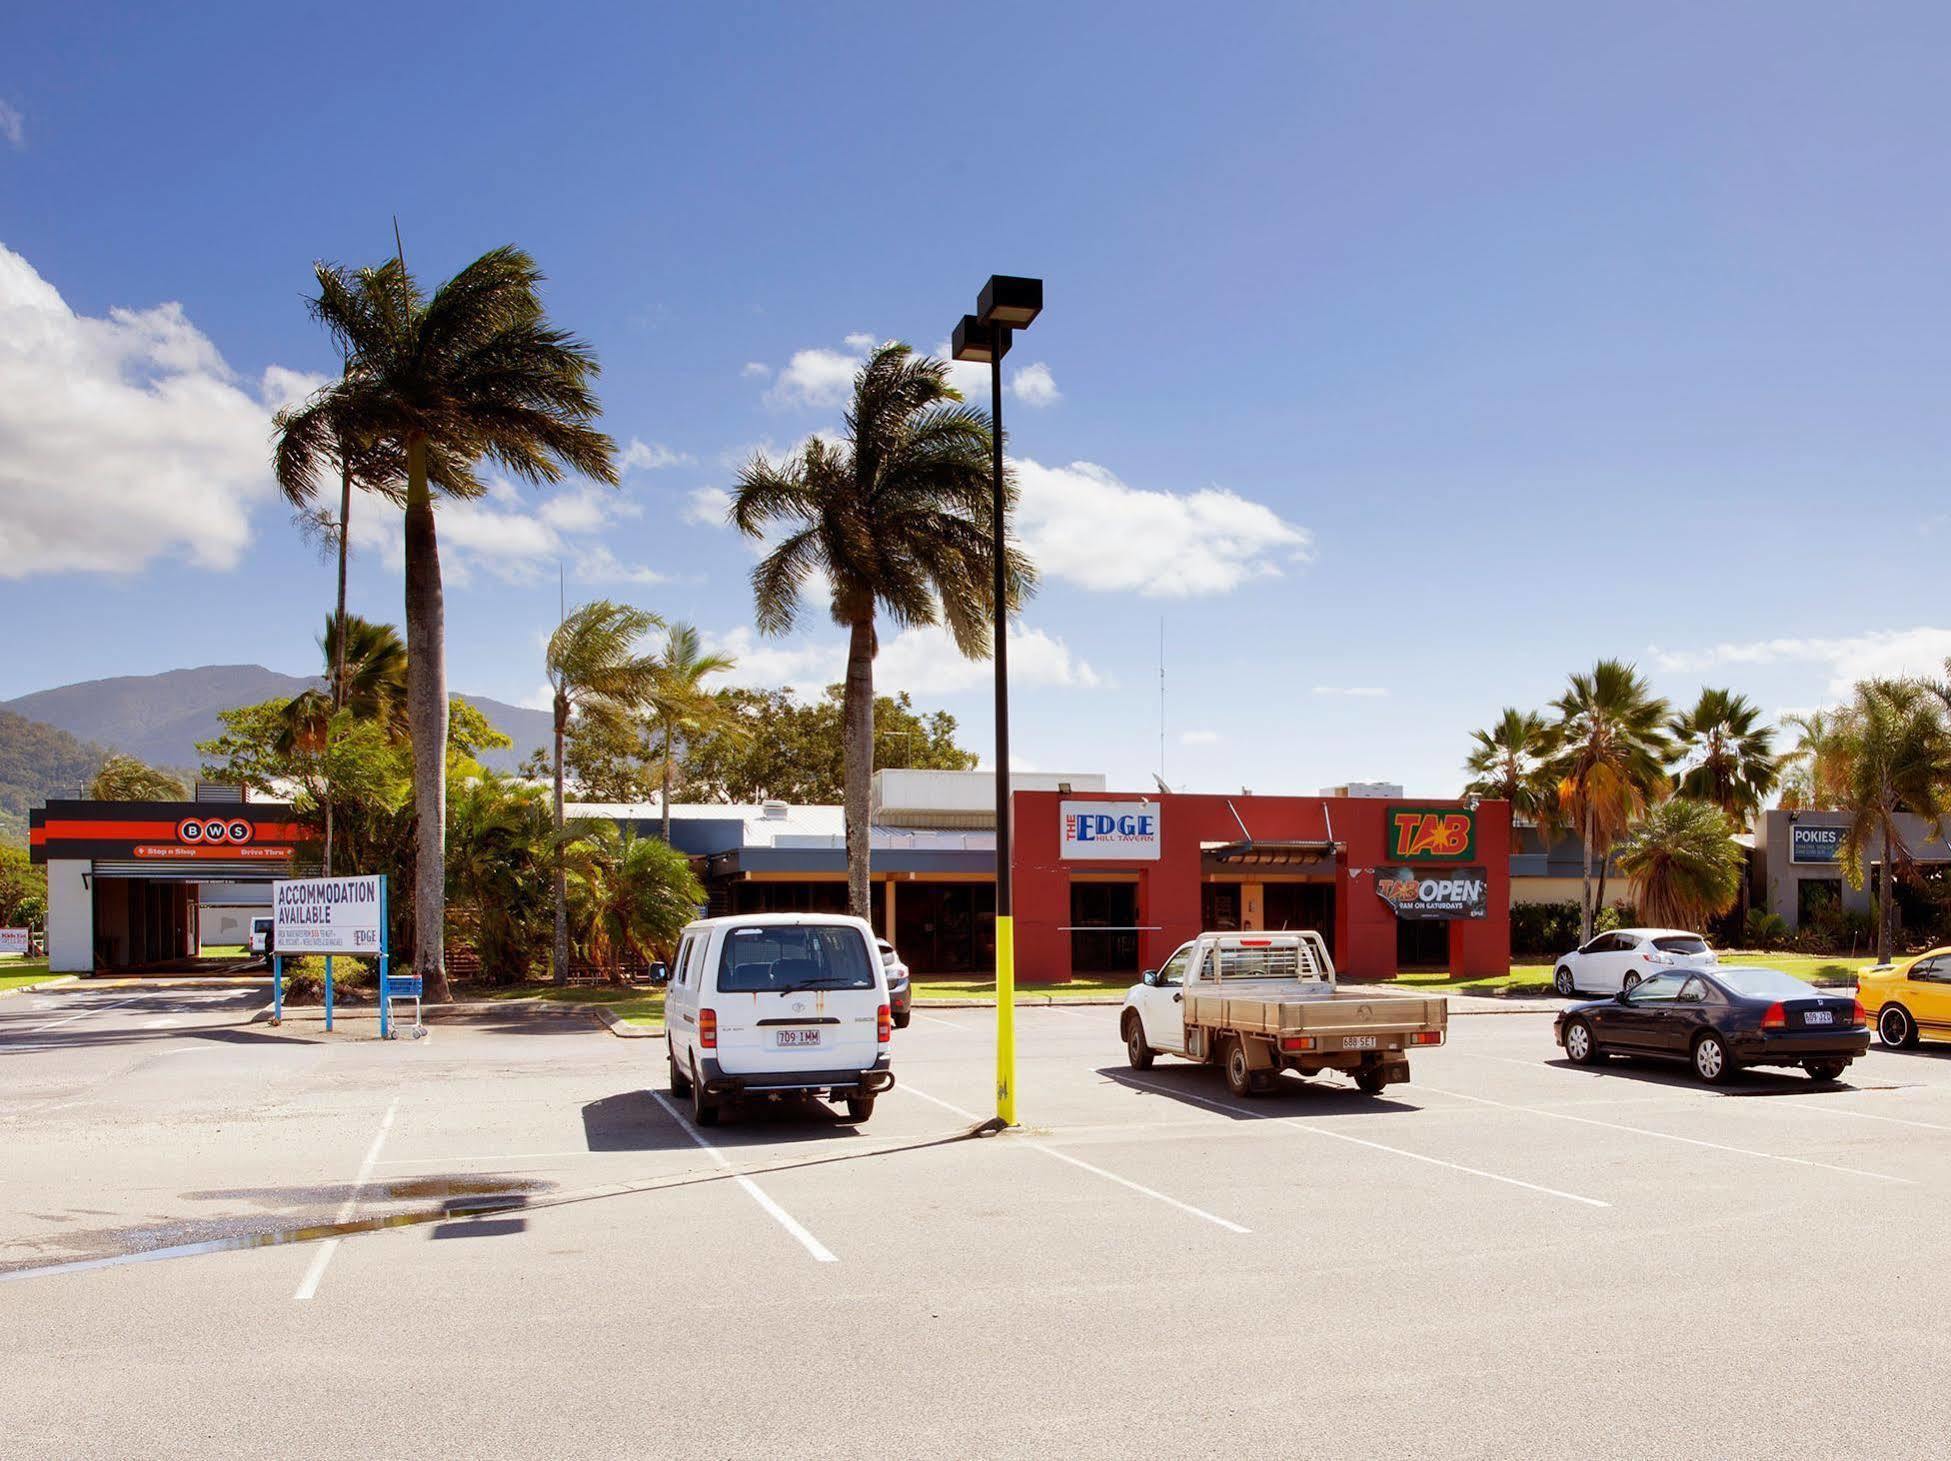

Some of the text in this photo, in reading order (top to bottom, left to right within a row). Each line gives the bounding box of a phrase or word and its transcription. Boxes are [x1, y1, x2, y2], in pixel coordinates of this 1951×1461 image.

[1066, 814, 1076, 841] THE
[1077, 814, 1154, 841] EDGE
[1395, 814, 1470, 855] TAB
[1795, 830, 1837, 843] POKIES
[147, 848, 167, 857] Stop
[175, 848, 196, 857] Shop
[241, 848, 284, 856] Drive Thru
[278, 881, 375, 905] ACCOMMODATION
[1378, 879, 1481, 902] TAB OPEN
[278, 906, 331, 924] AVAILABLE
[356, 930, 376, 946] EDGE
[779, 1031, 818, 1042] 709 IMM
[1360, 1036, 1374, 1046] SET
